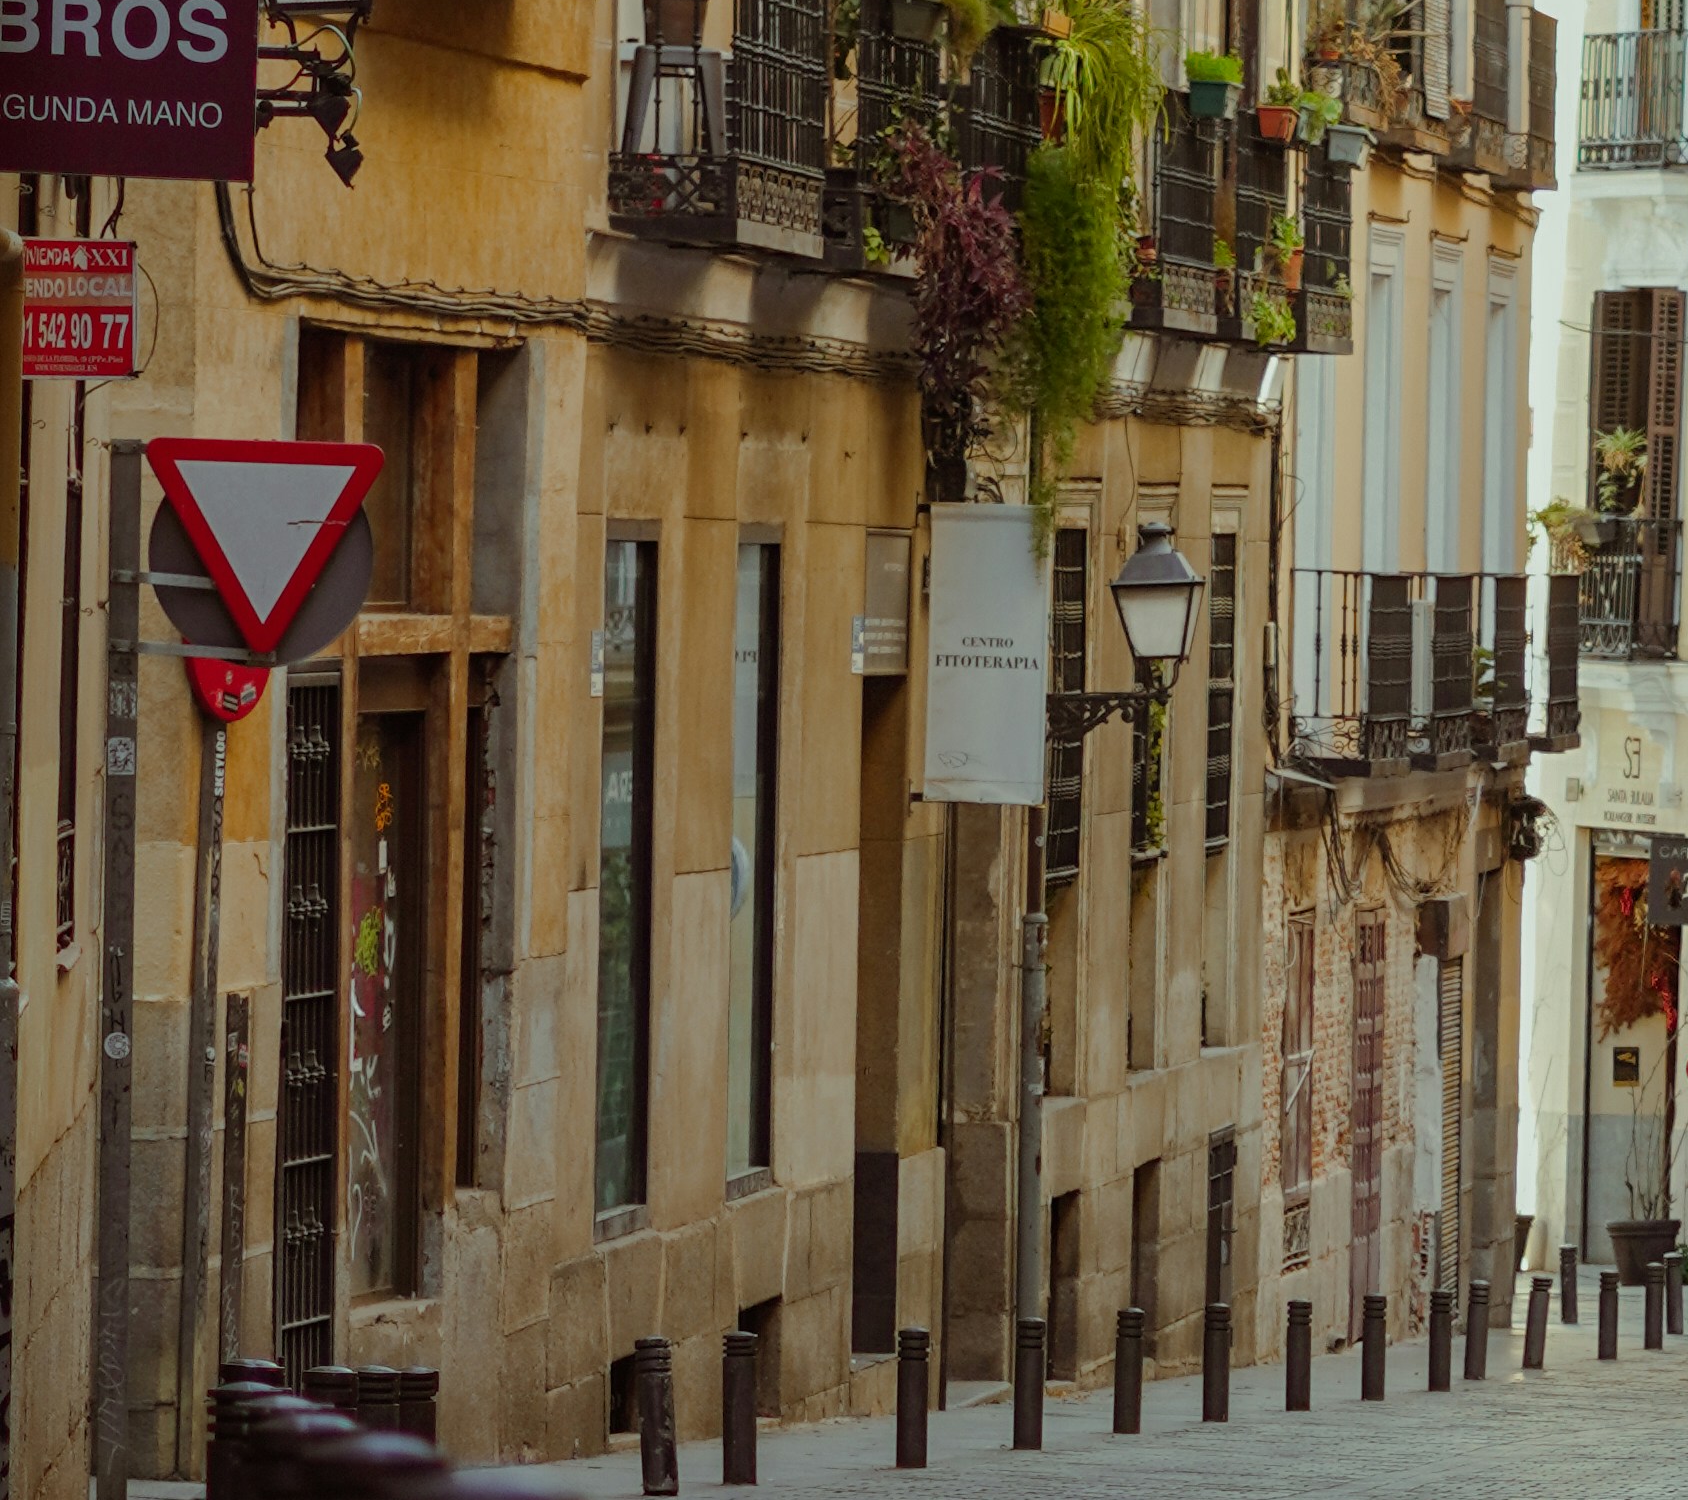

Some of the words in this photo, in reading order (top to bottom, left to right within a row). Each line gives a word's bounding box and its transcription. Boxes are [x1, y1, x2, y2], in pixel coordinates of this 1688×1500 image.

[0, 93, 119, 125] GUNDA
[127, 99, 223, 129] MANO
[24, 246, 72, 266] IVIENDA
[91, 248, 128, 267] XXI
[24, 278, 66, 298] ENDO
[68, 276, 132, 297] LOCAL
[22, 313, 34, 348] 1
[38, 313, 66, 348] 542
[71, 313, 93, 349] 90
[100, 314, 129, 349] 77
[961, 636, 1014, 649] CENTRO
[935, 654, 1040, 670] FITOTERAPIA
